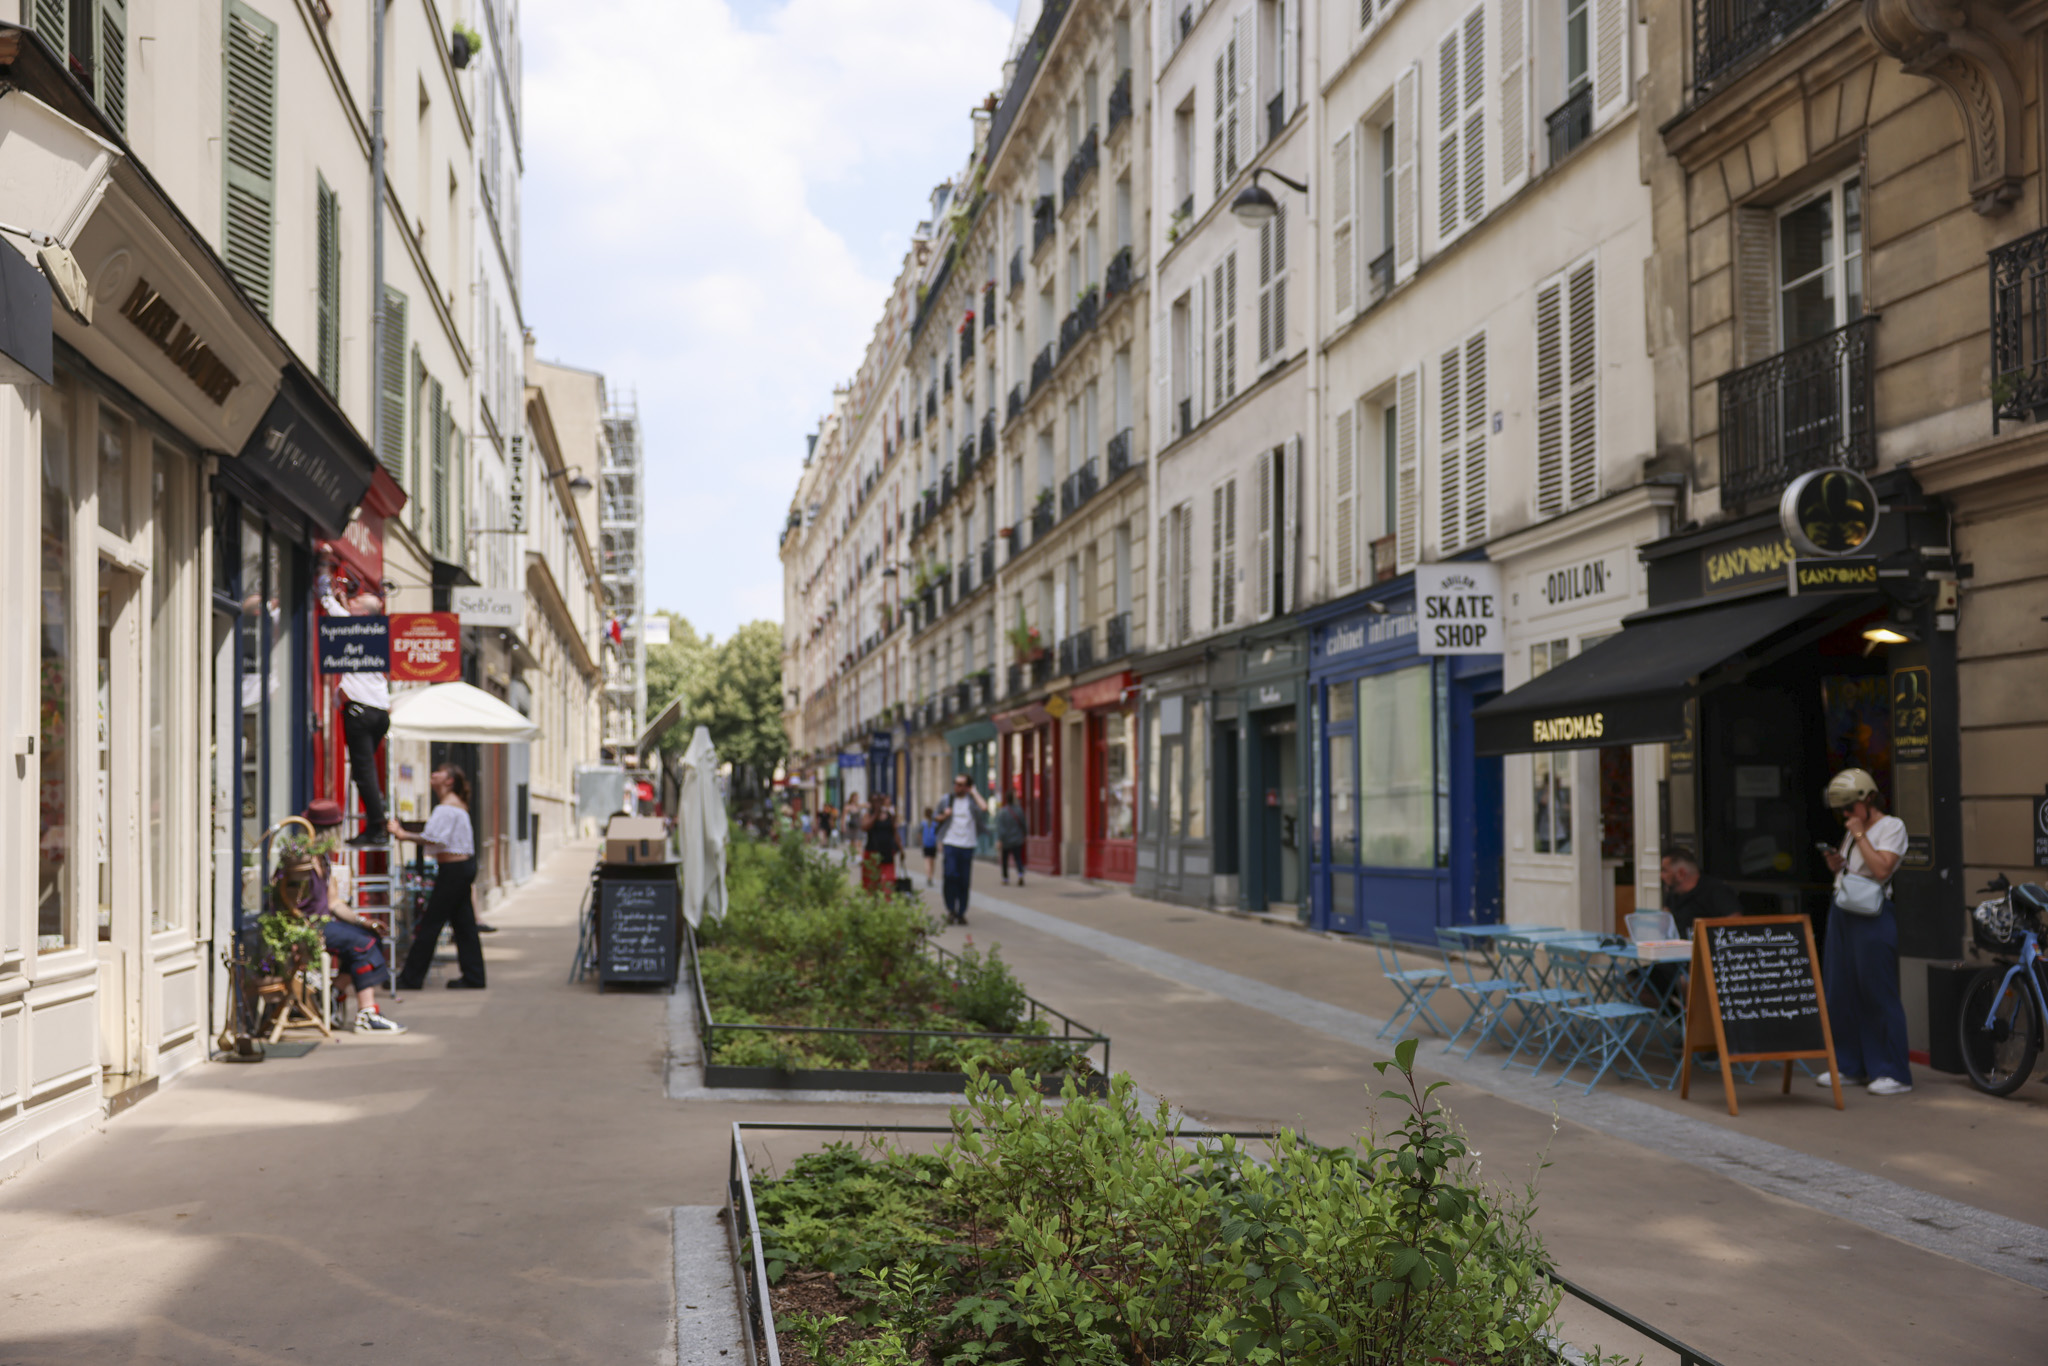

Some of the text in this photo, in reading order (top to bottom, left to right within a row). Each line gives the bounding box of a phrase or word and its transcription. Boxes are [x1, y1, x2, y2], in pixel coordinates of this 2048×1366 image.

[511, 436, 523, 531] RESTAURANT
[1706, 538, 1796, 584] FANTOMAS
[1547, 559, 1605, 605] ODILON
[1800, 565, 1876, 585] FANTOMAS
[1425, 595, 1494, 619] SKATE
[393, 638, 456, 652] EPICERIE
[1326, 624, 1364, 656] cabinet
[1434, 624, 1487, 647] SHOP
[343, 642, 364, 655] Art
[407, 651, 441, 663] FINE
[1533, 712, 1603, 743] FANTOMAS
